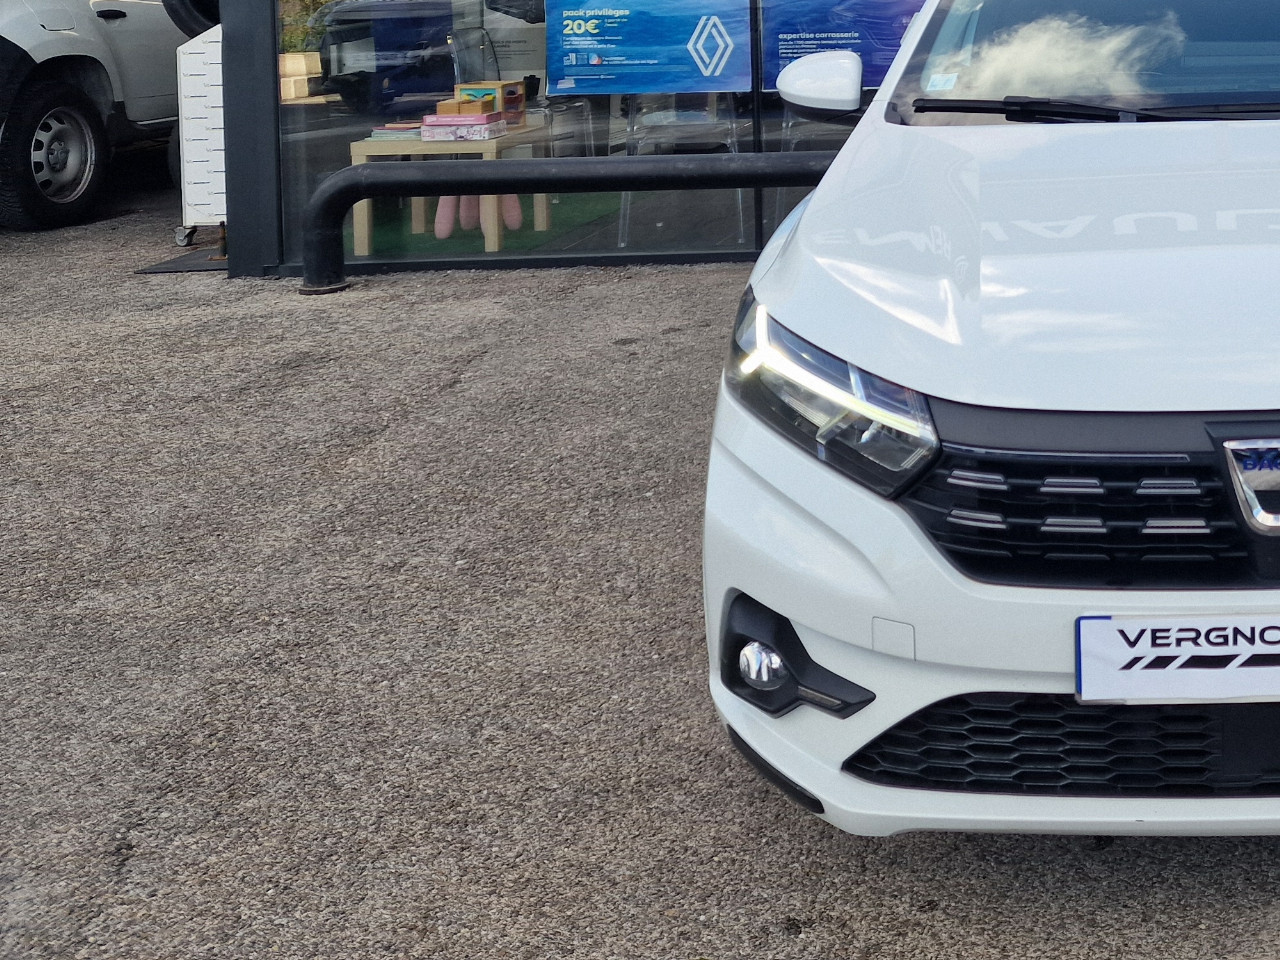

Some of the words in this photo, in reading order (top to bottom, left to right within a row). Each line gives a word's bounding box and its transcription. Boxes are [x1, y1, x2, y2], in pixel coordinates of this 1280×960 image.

[562, 19, 600, 34] 20€
[778, 32, 814, 40] expertise
[815, 30, 860, 39] carrosserie
